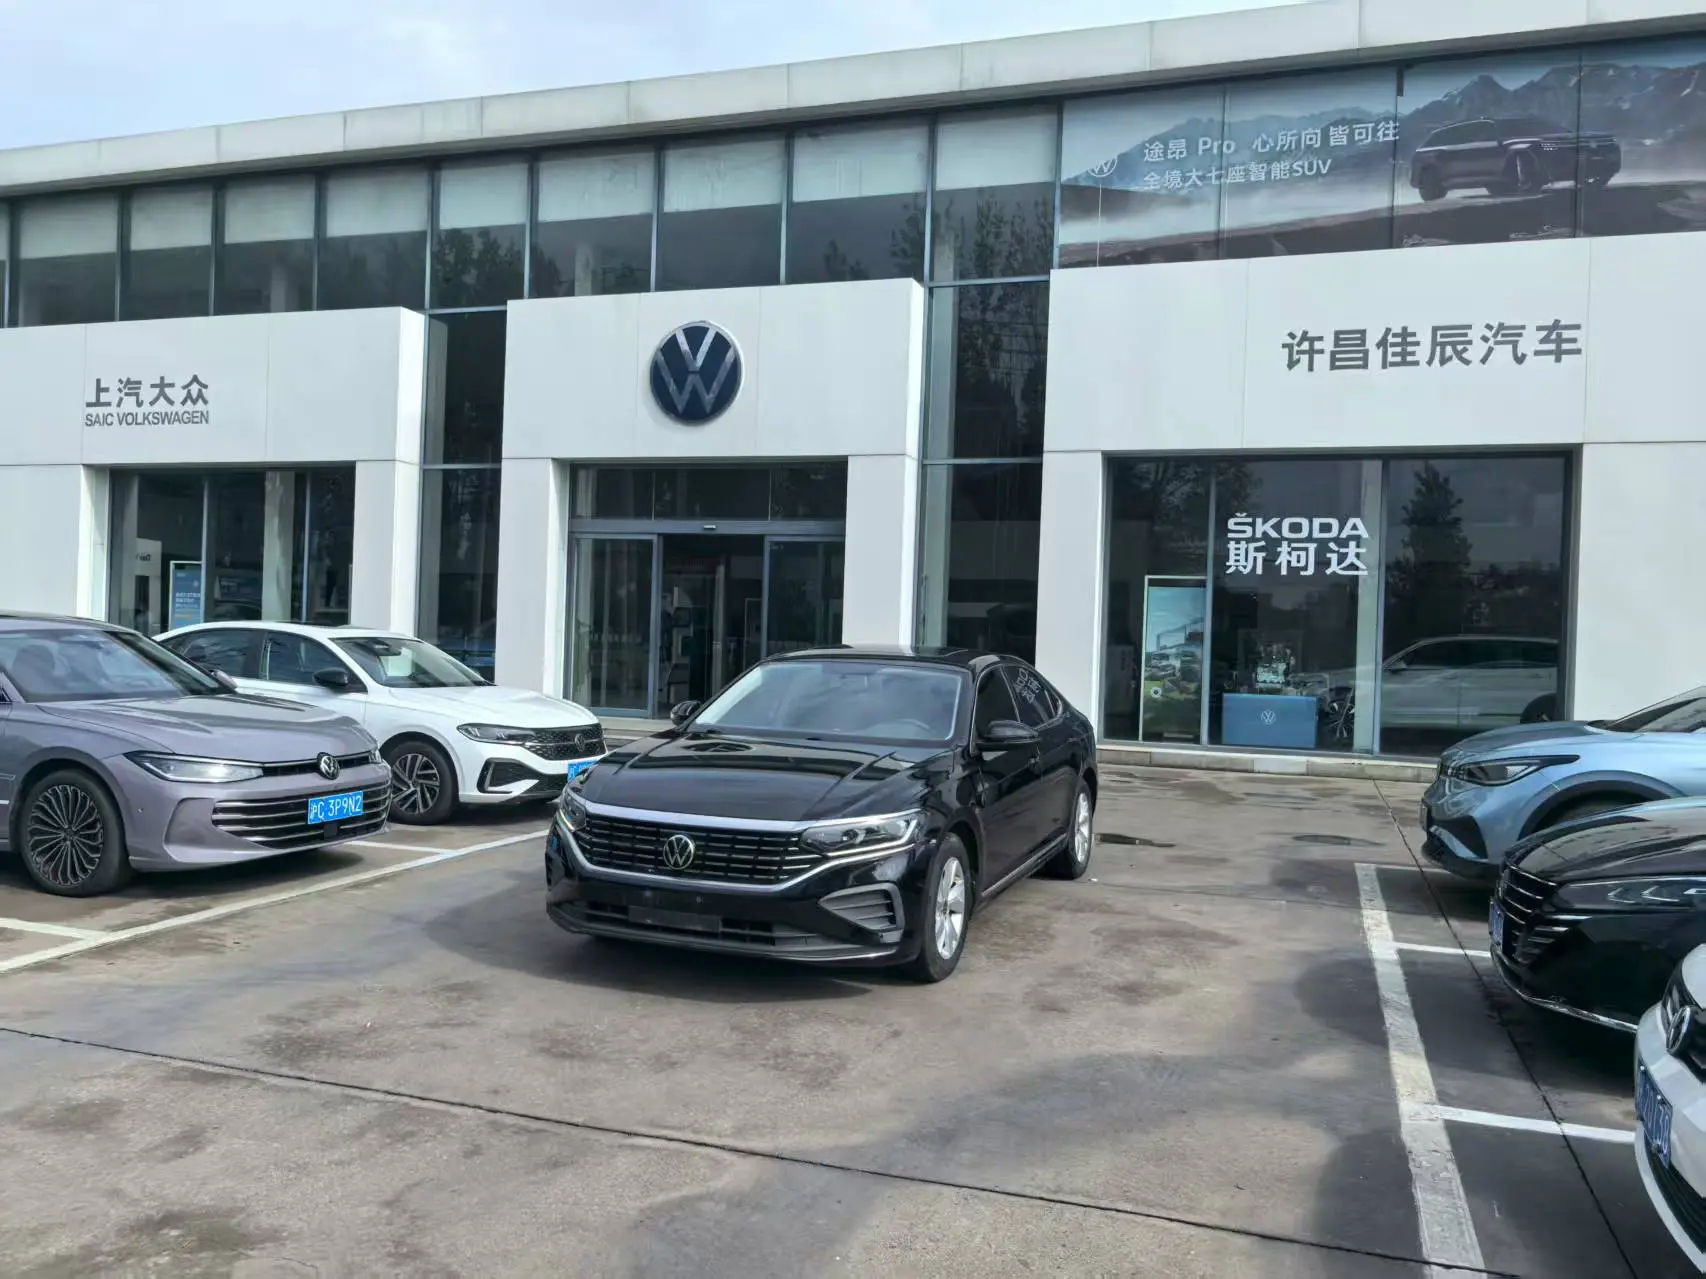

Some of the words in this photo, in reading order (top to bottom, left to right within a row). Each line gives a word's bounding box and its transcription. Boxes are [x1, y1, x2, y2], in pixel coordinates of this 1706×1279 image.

[1143, 138, 1187, 162] 途昂
[1198, 135, 1236, 156] Pro
[1281, 318, 1583, 373] 许昌佳辰汽车
[652, 322, 740, 420] VW
[85, 374, 209, 408] 上汽大众
[85, 412, 115, 427] SAIC
[116, 410, 210, 426] VOLKSWAGEN
[1227, 512, 1369, 539] ŠKODA
[1225, 540, 1369, 576] 斯柯达
[663, 834, 694, 869] VW
